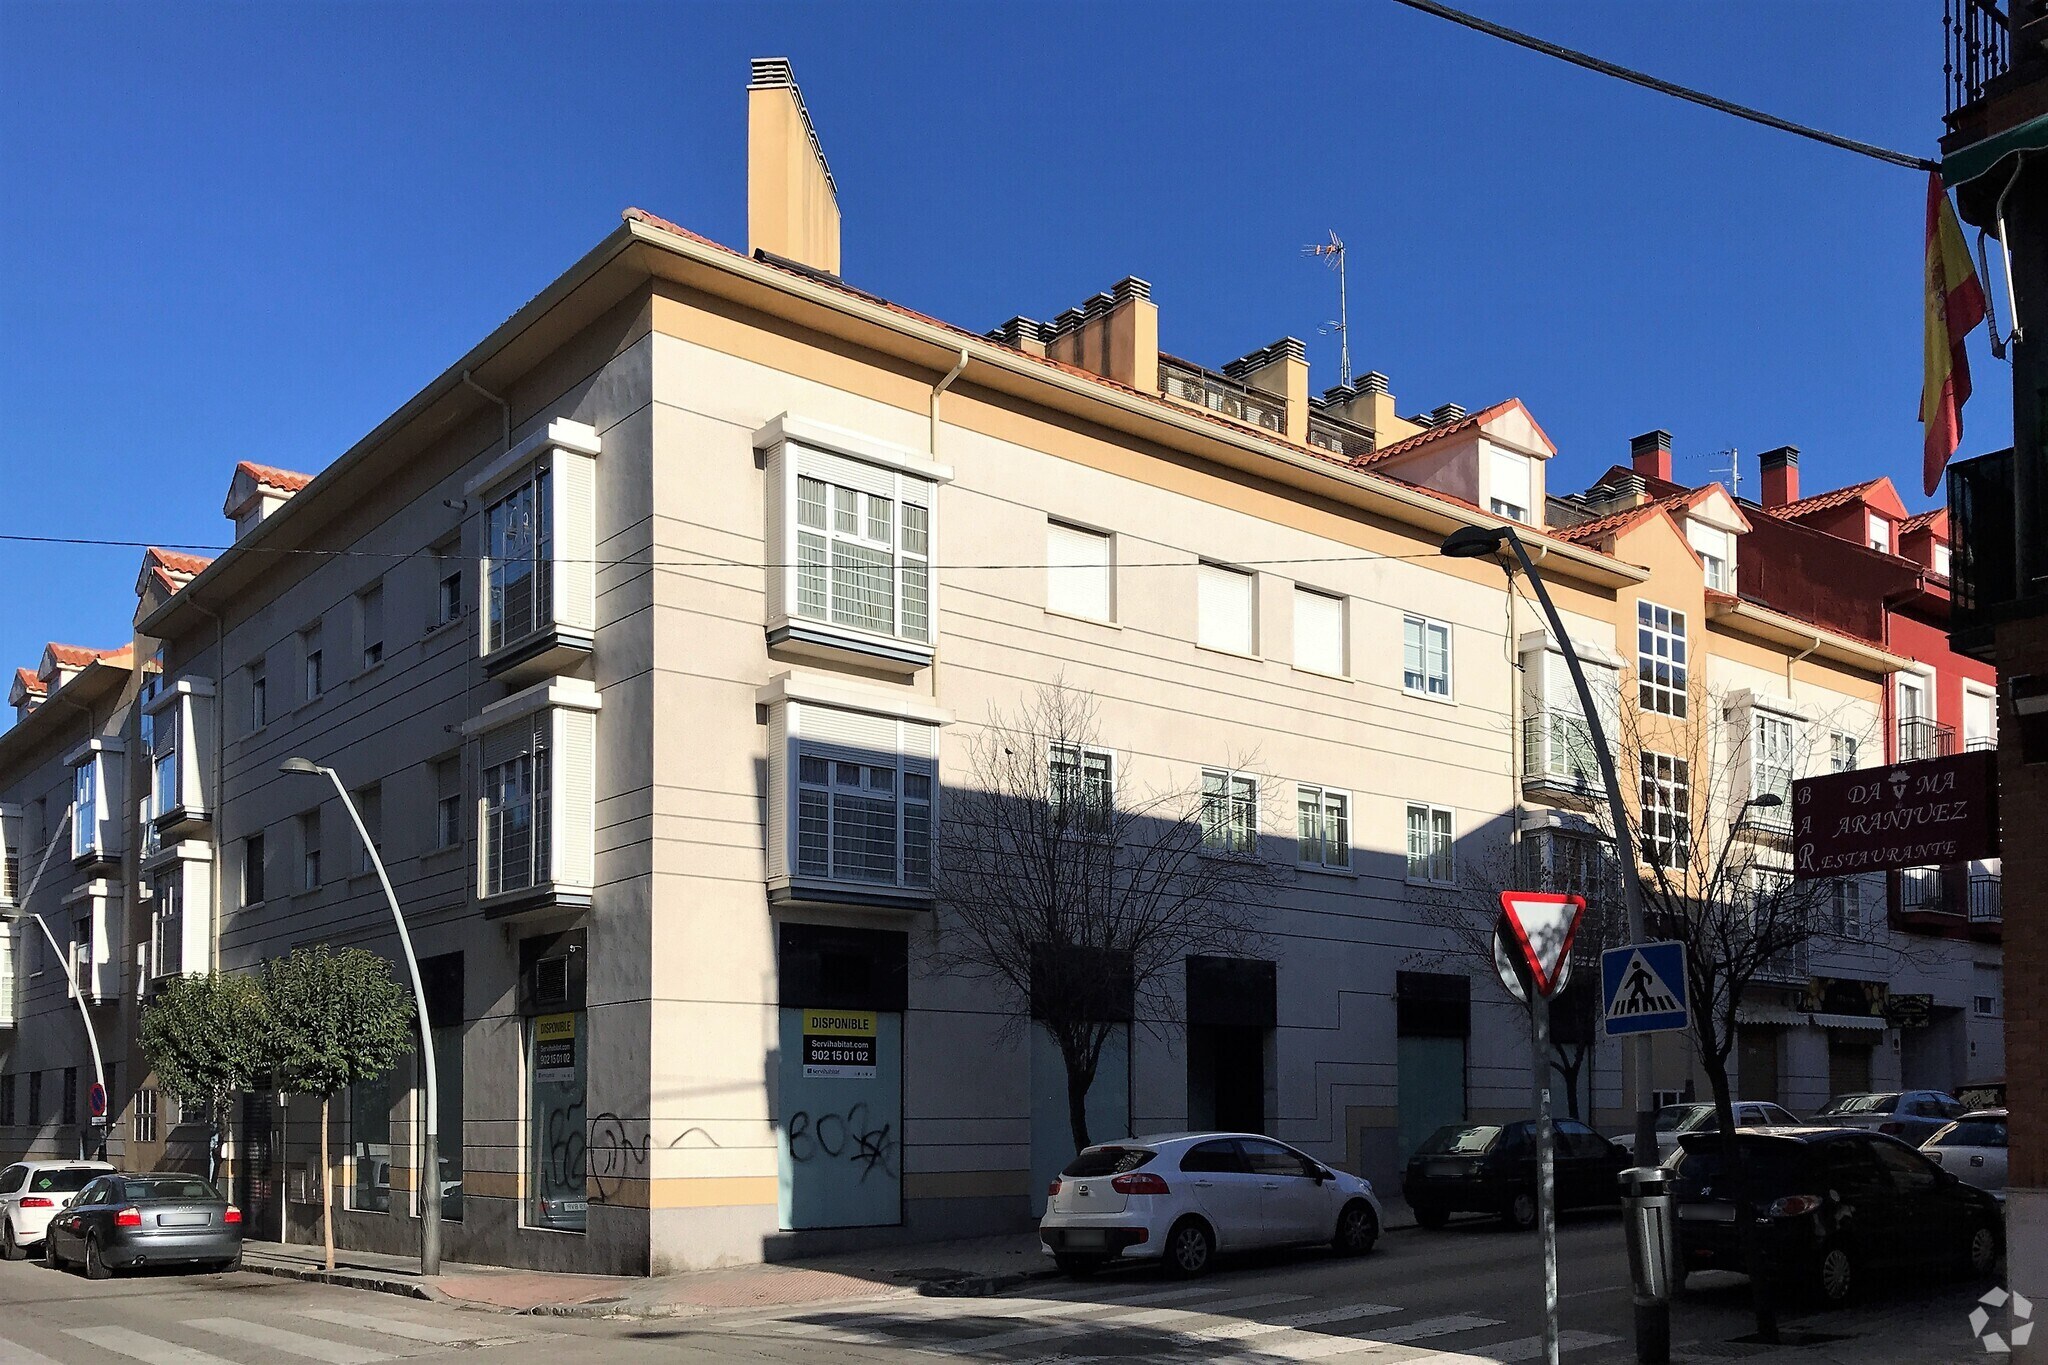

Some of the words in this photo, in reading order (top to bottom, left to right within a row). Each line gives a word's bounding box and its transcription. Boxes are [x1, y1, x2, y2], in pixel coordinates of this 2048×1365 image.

[1832, 801, 1968, 838] ARANJUEZ
[540, 1021, 571, 1033] DISPONIBLE
[812, 1016, 870, 1030] DISPONIBLE
[811, 1039, 869, 1049] Servihabitat.com
[811, 1050, 830, 1061] 902
[831, 1050, 842, 1061] 15
[843, 1051, 854, 1061] 01
[856, 1051, 869, 1061] 02
